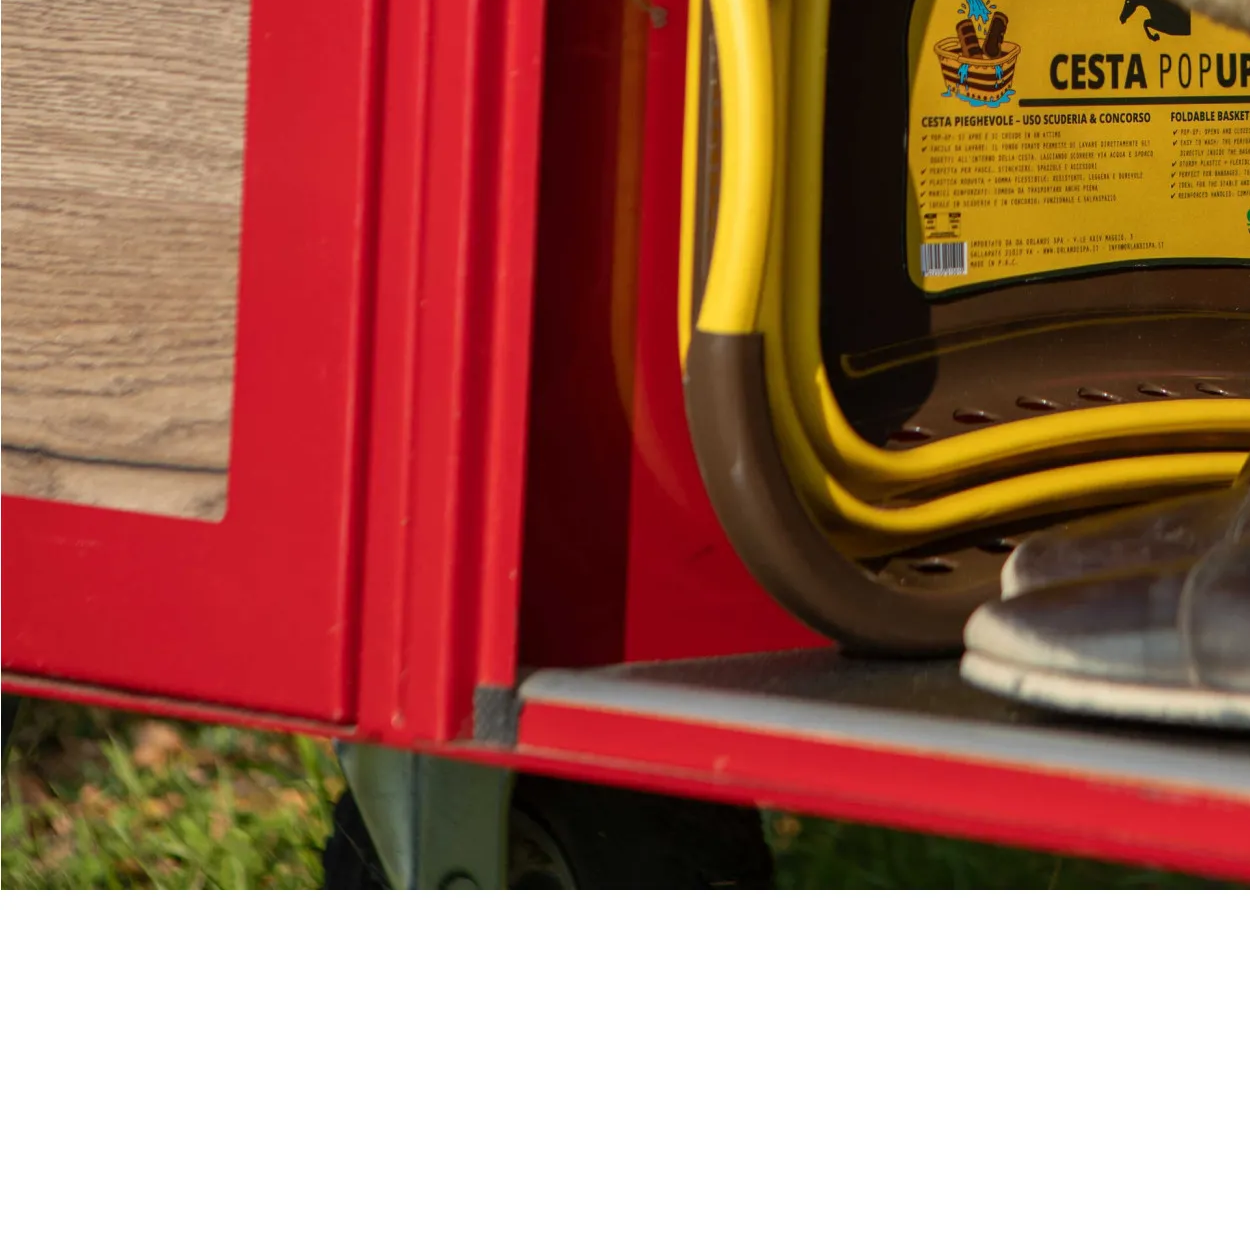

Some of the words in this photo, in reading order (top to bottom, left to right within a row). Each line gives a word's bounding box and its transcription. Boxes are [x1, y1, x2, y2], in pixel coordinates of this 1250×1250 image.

[1049, 53, 1147, 90] CESTA
[922, 116, 951, 127] CESTA
[955, 115, 1013, 127] PIEGHEVOLE
[1023, 115, 1041, 125] USO
[1044, 114, 1087, 125] SCUDERIA
[1090, 114, 1096, 124] &
[1100, 112, 1151, 123] CONCORSO
[1171, 111, 1215, 121] FOLDABLE
[1218, 111, 1250, 121] BASKET
